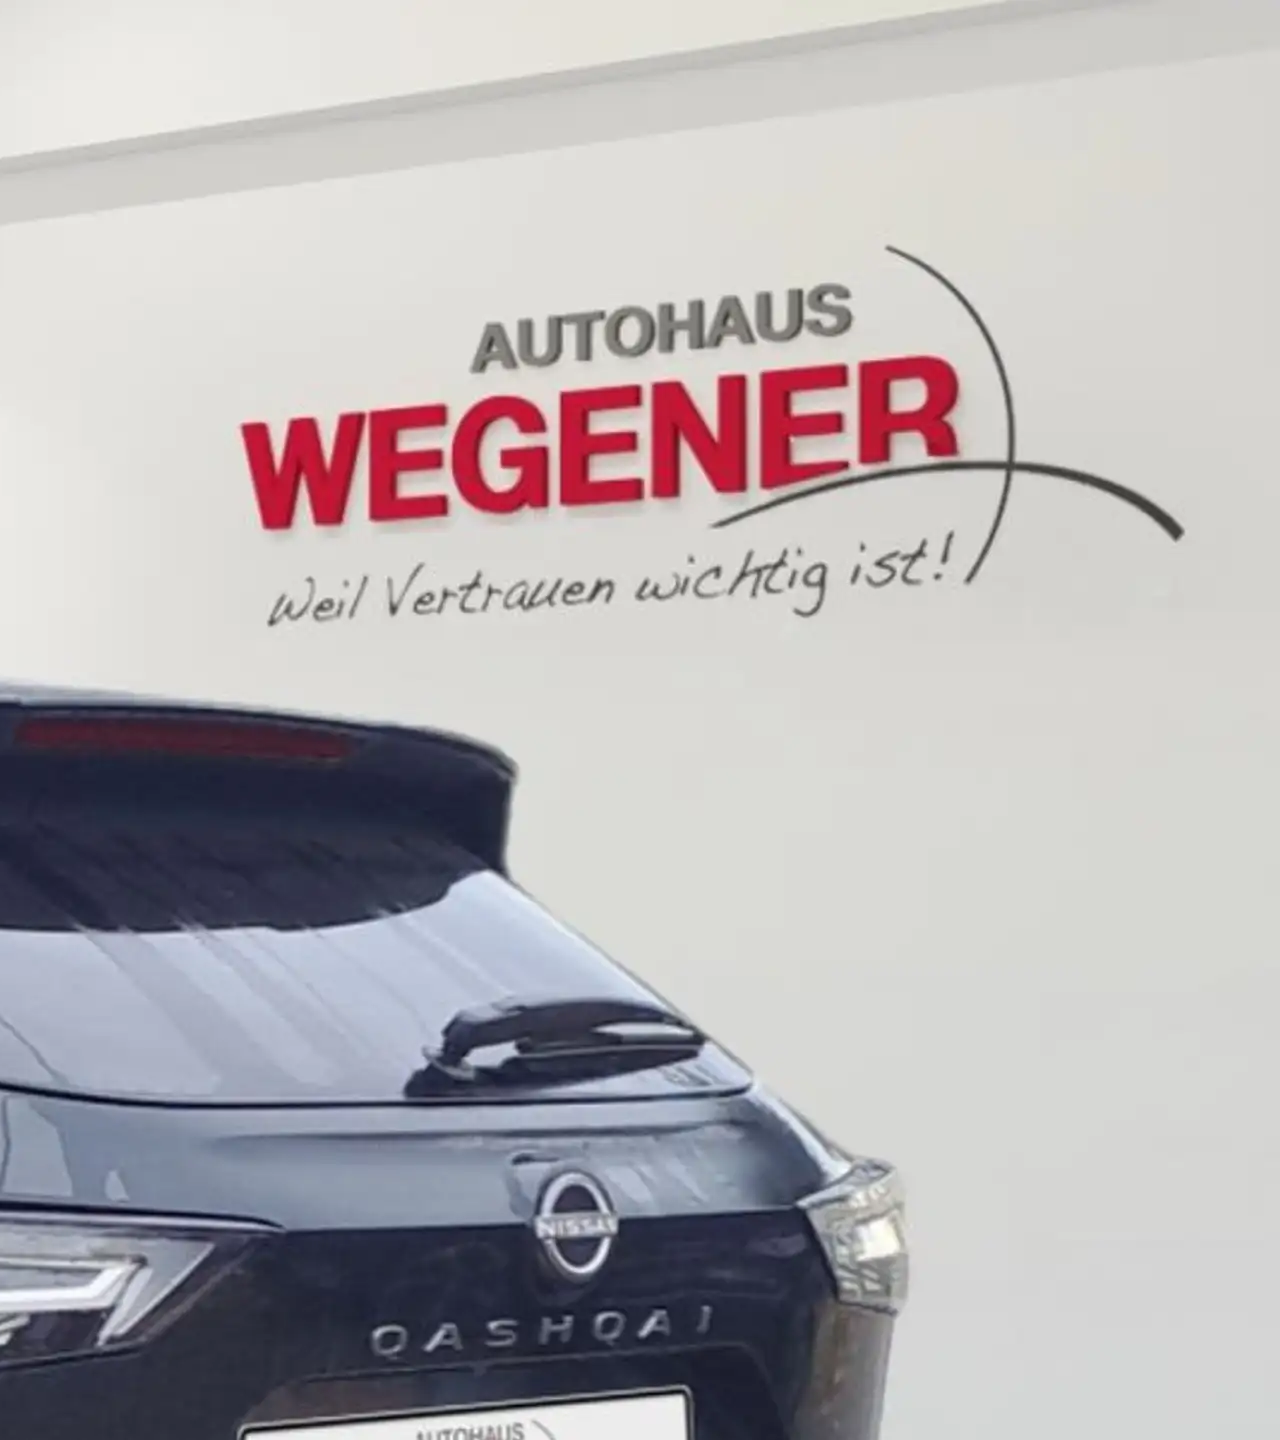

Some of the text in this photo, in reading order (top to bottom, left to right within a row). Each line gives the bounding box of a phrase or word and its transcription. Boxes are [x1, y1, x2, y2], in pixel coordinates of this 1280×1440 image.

[471, 284, 853, 373] AUTOHAUS
[241, 355, 960, 530] WEGENER
[267, 530, 955, 627] Weil Vertrauen wichtig ist!
[535, 1214, 619, 1239] NISSAN
[371, 1304, 713, 1360] QASHQAI
